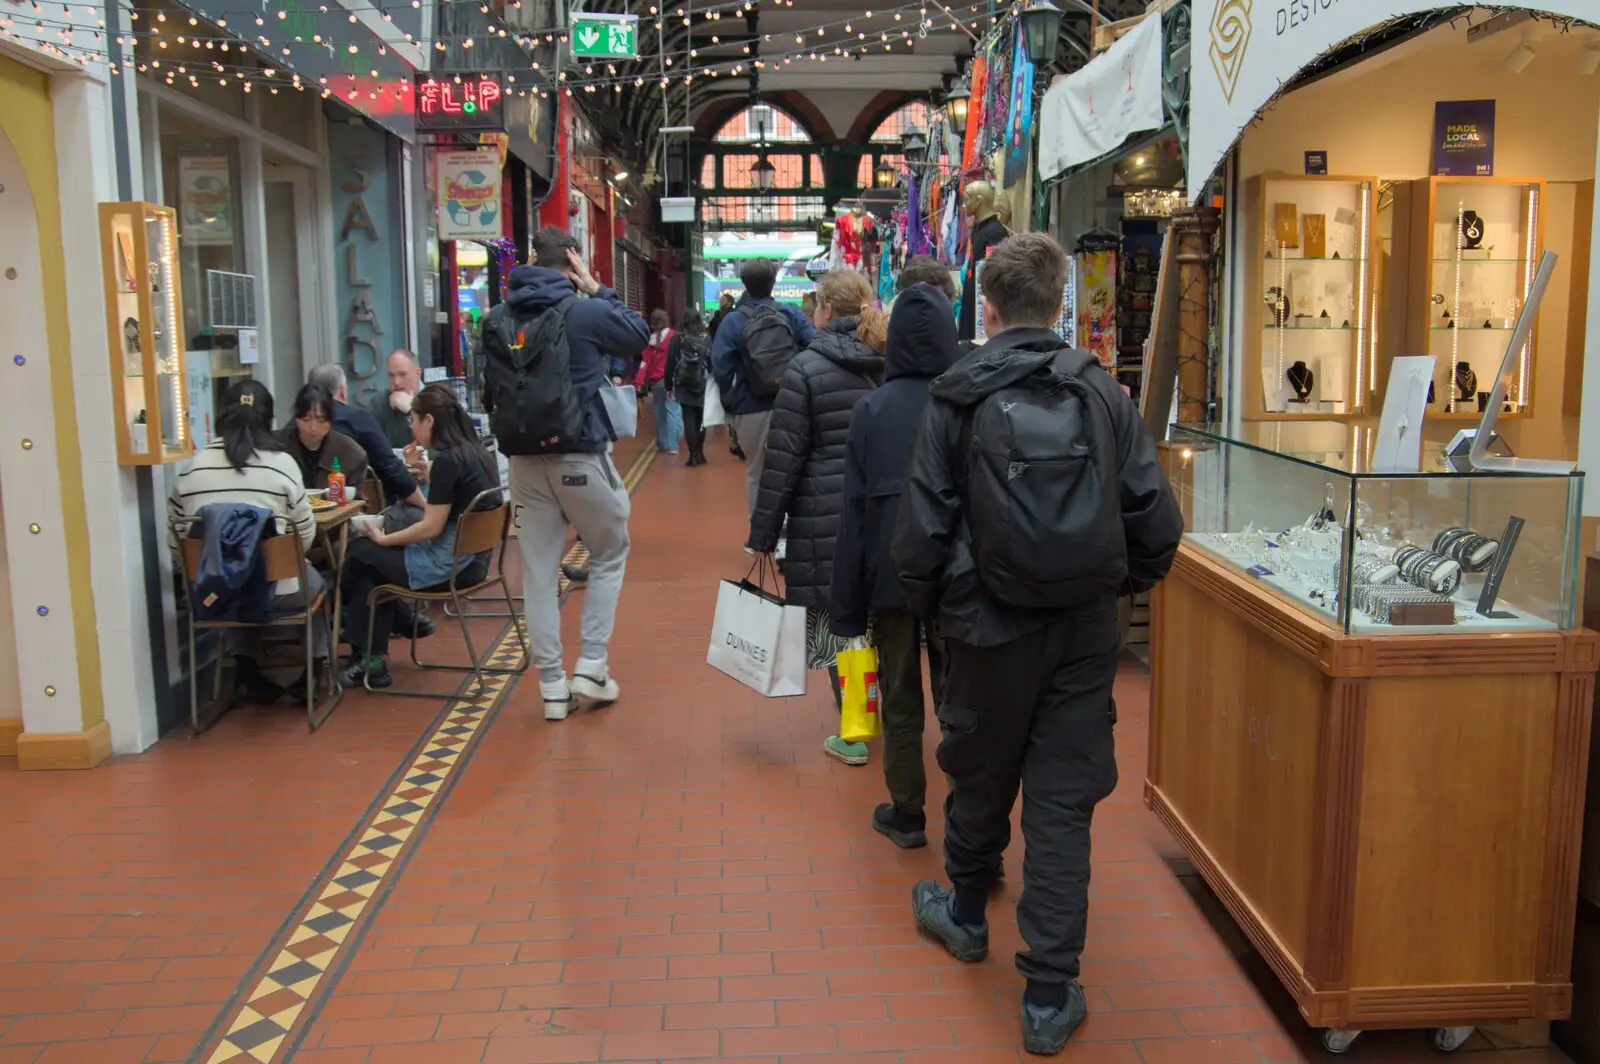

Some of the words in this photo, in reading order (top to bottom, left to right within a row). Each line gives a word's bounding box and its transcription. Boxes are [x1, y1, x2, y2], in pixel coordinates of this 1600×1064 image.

[1276, 0, 1339, 36] DESI
[1447, 133, 1480, 141] LOCAL
[726, 631, 768, 663] DUNNES
